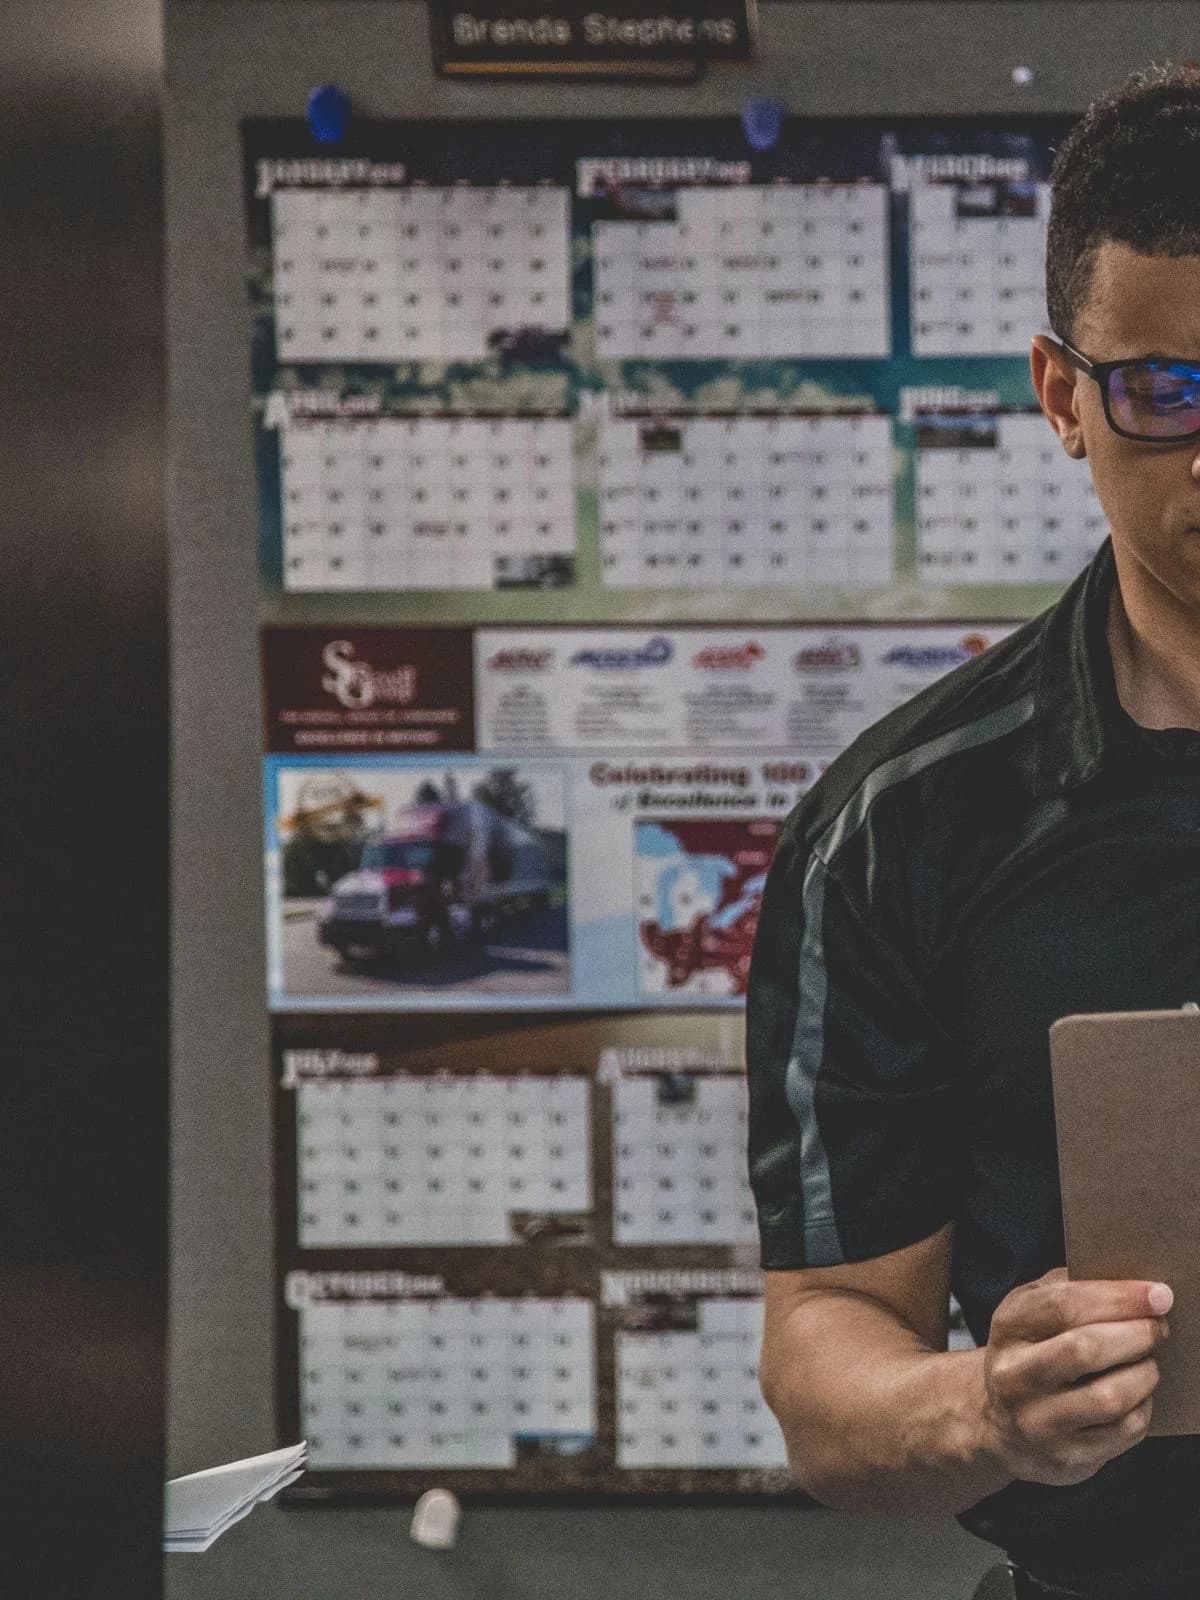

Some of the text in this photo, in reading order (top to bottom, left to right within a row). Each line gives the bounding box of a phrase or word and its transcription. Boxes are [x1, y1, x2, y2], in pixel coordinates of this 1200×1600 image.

[453, 13, 737, 45] Brenda Stephens
[589, 760, 808, 787] Celebrating 100
